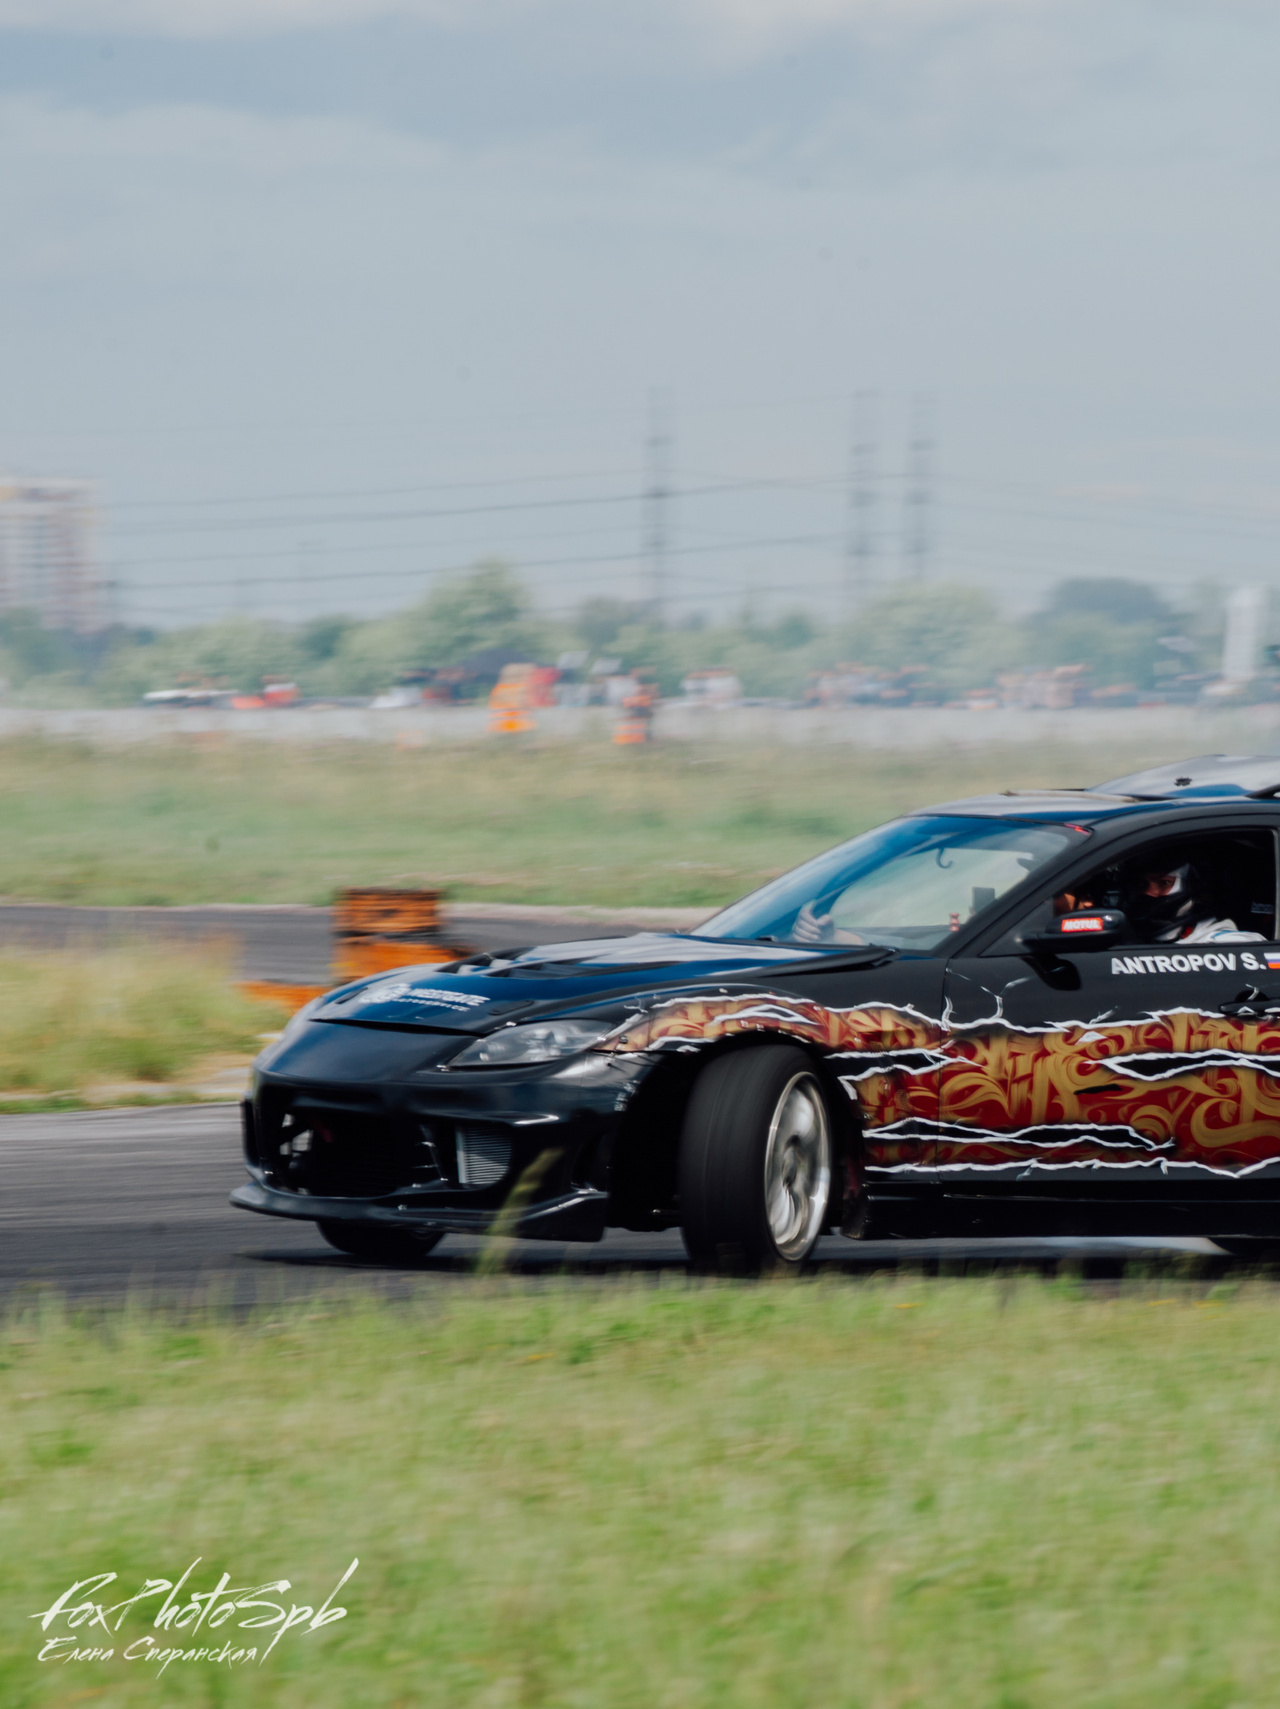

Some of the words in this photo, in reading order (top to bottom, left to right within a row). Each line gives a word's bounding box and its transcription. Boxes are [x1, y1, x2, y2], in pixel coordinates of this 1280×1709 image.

[1063, 919, 1102, 930] MOTUL
[1111, 953, 1236, 974] ANTROPOV
[1240, 952, 1266, 970] S.
